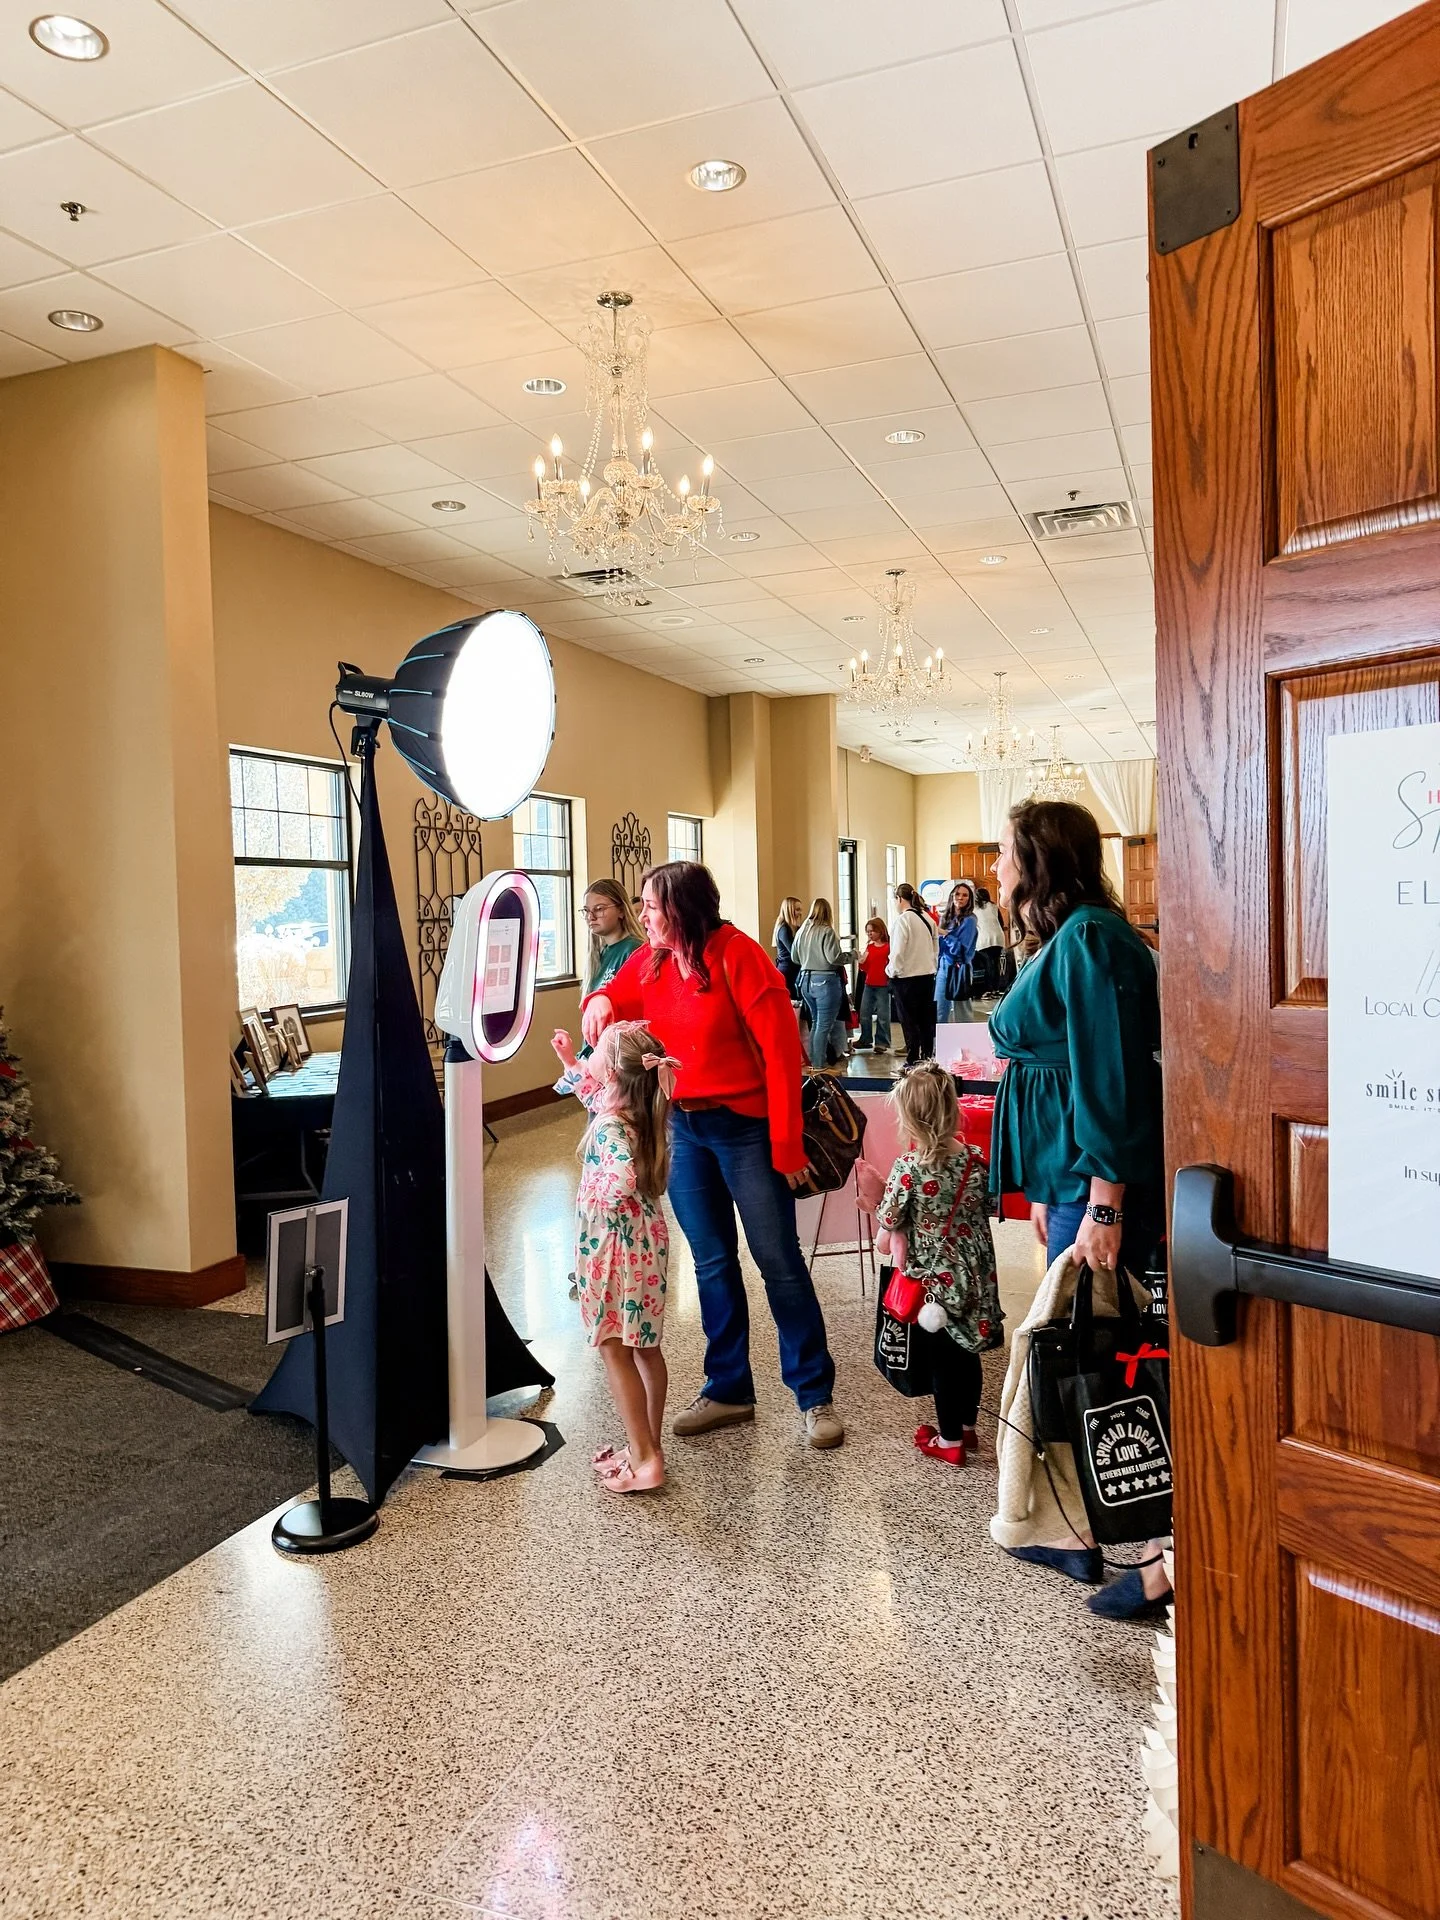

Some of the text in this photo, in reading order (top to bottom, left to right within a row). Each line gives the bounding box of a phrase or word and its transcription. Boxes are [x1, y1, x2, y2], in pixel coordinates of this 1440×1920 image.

[1365, 1079, 1418, 1101] smile
[1404, 1165, 1440, 1187] In su
[1152, 1302, 1168, 1315] LOV
[1096, 1422, 1160, 1466] SPREAD LOCAL
[1114, 1443, 1142, 1463] LOVE
[1121, 1464, 1136, 1476] MAKE
